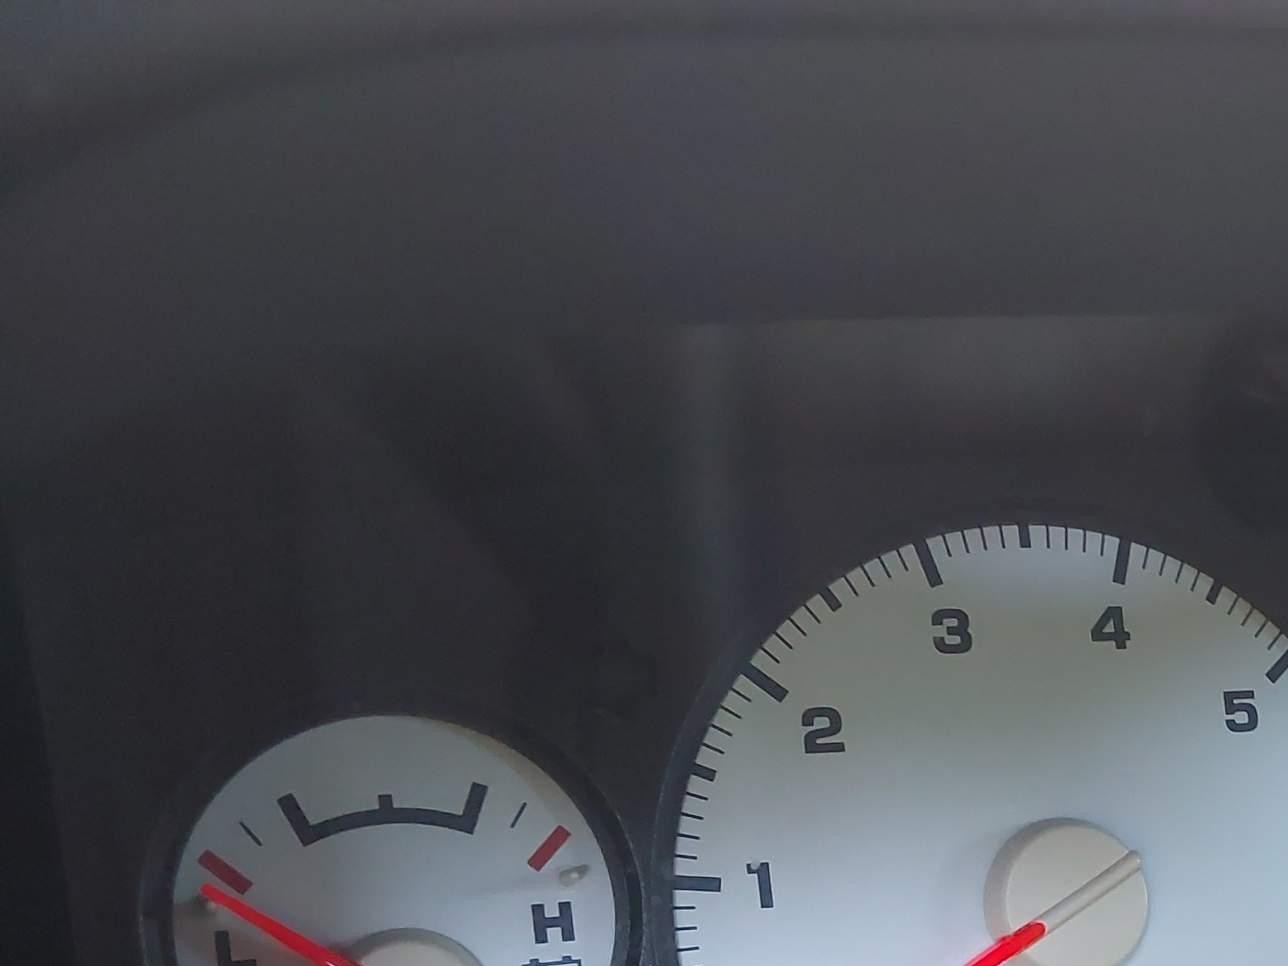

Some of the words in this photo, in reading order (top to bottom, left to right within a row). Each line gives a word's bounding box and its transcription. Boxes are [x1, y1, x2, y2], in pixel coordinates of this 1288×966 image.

[932, 608, 973, 654] 3
[1090, 607, 1131, 649] 4
[803, 706, 845, 754] 2
[1223, 690, 1259, 733] 5
[746, 861, 775, 908] 1
[531, 901, 576, 944] H
